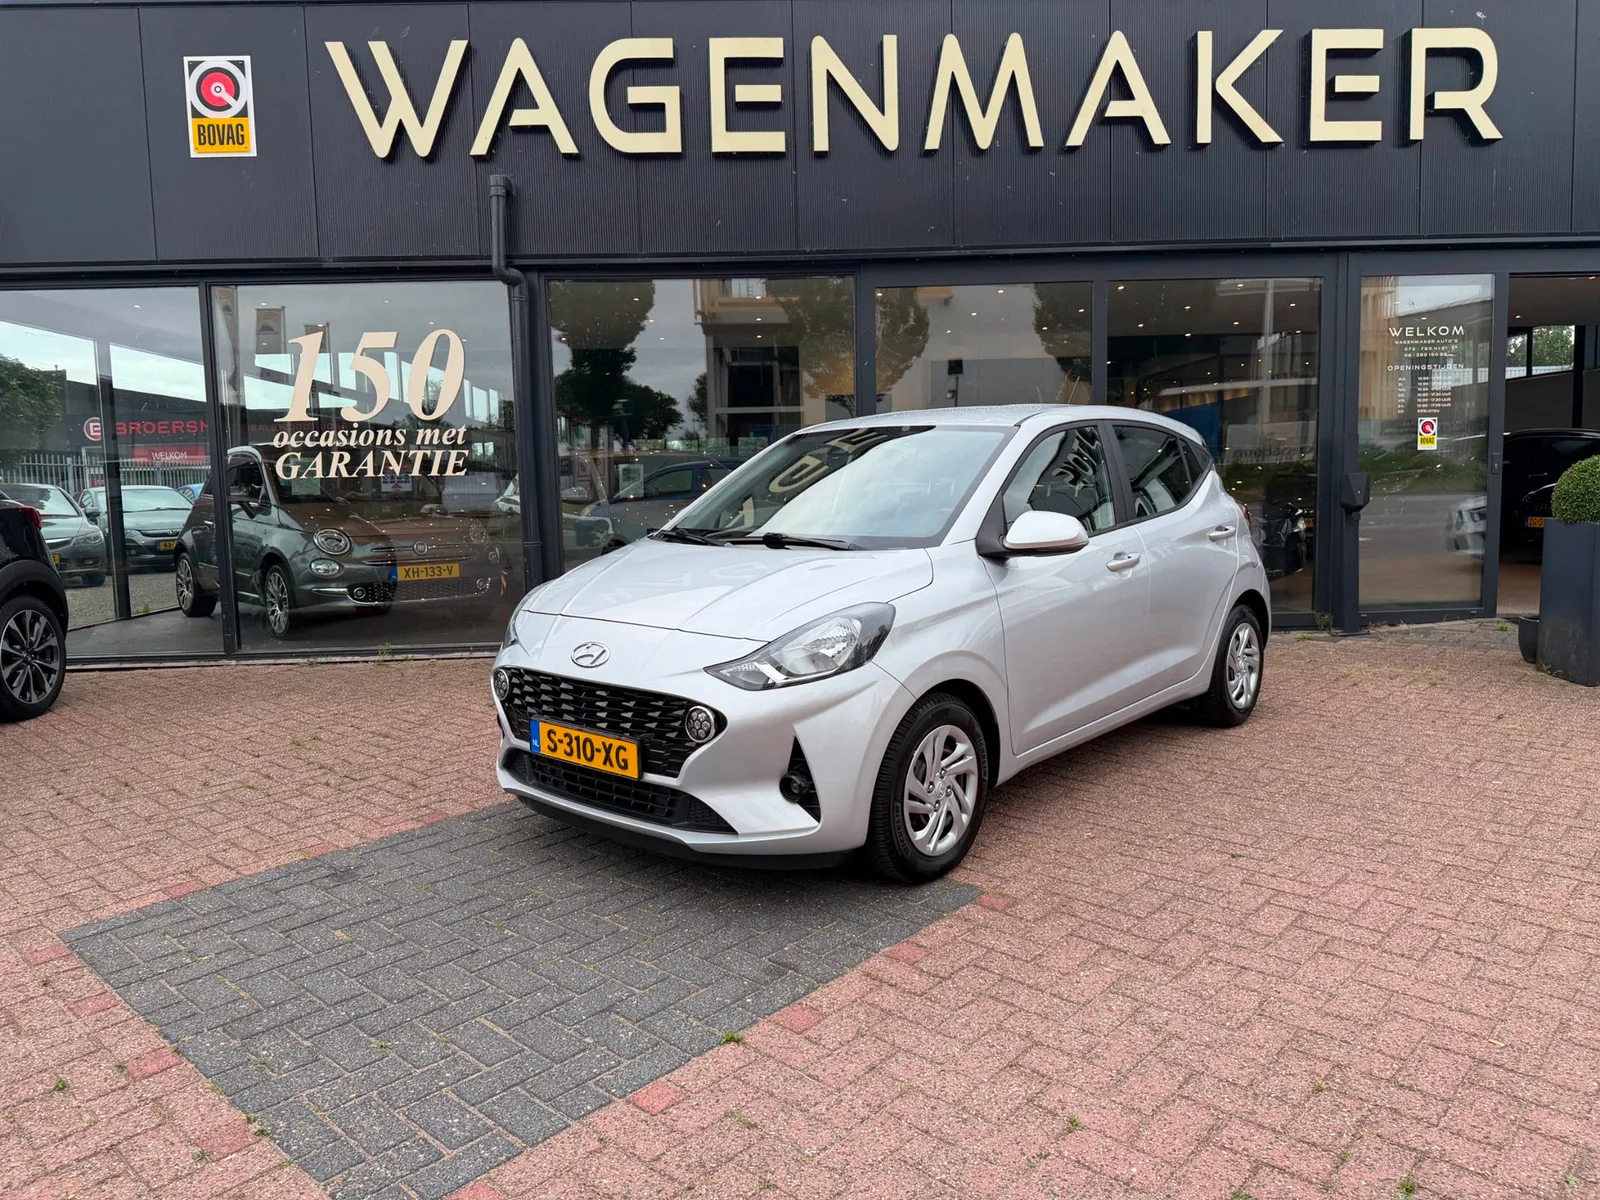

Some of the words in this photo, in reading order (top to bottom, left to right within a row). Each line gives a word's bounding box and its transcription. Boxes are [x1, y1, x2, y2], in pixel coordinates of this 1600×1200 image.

[324, 27, 1504, 159] WAGENMAKER
[197, 124, 245, 146] BOVAG
[1388, 325, 1465, 337] WELKOM
[273, 328, 465, 422] 150
[1387, 363, 1464, 371] OPENINGSTIJDEN
[273, 423, 407, 448] occasions
[416, 424, 467, 446] met
[151, 451, 187, 461] WELKOM
[275, 450, 469, 480] GARANTIE
[403, 565, 453, 579] XH-133-V
[546, 728, 628, 771] S-310-XG
